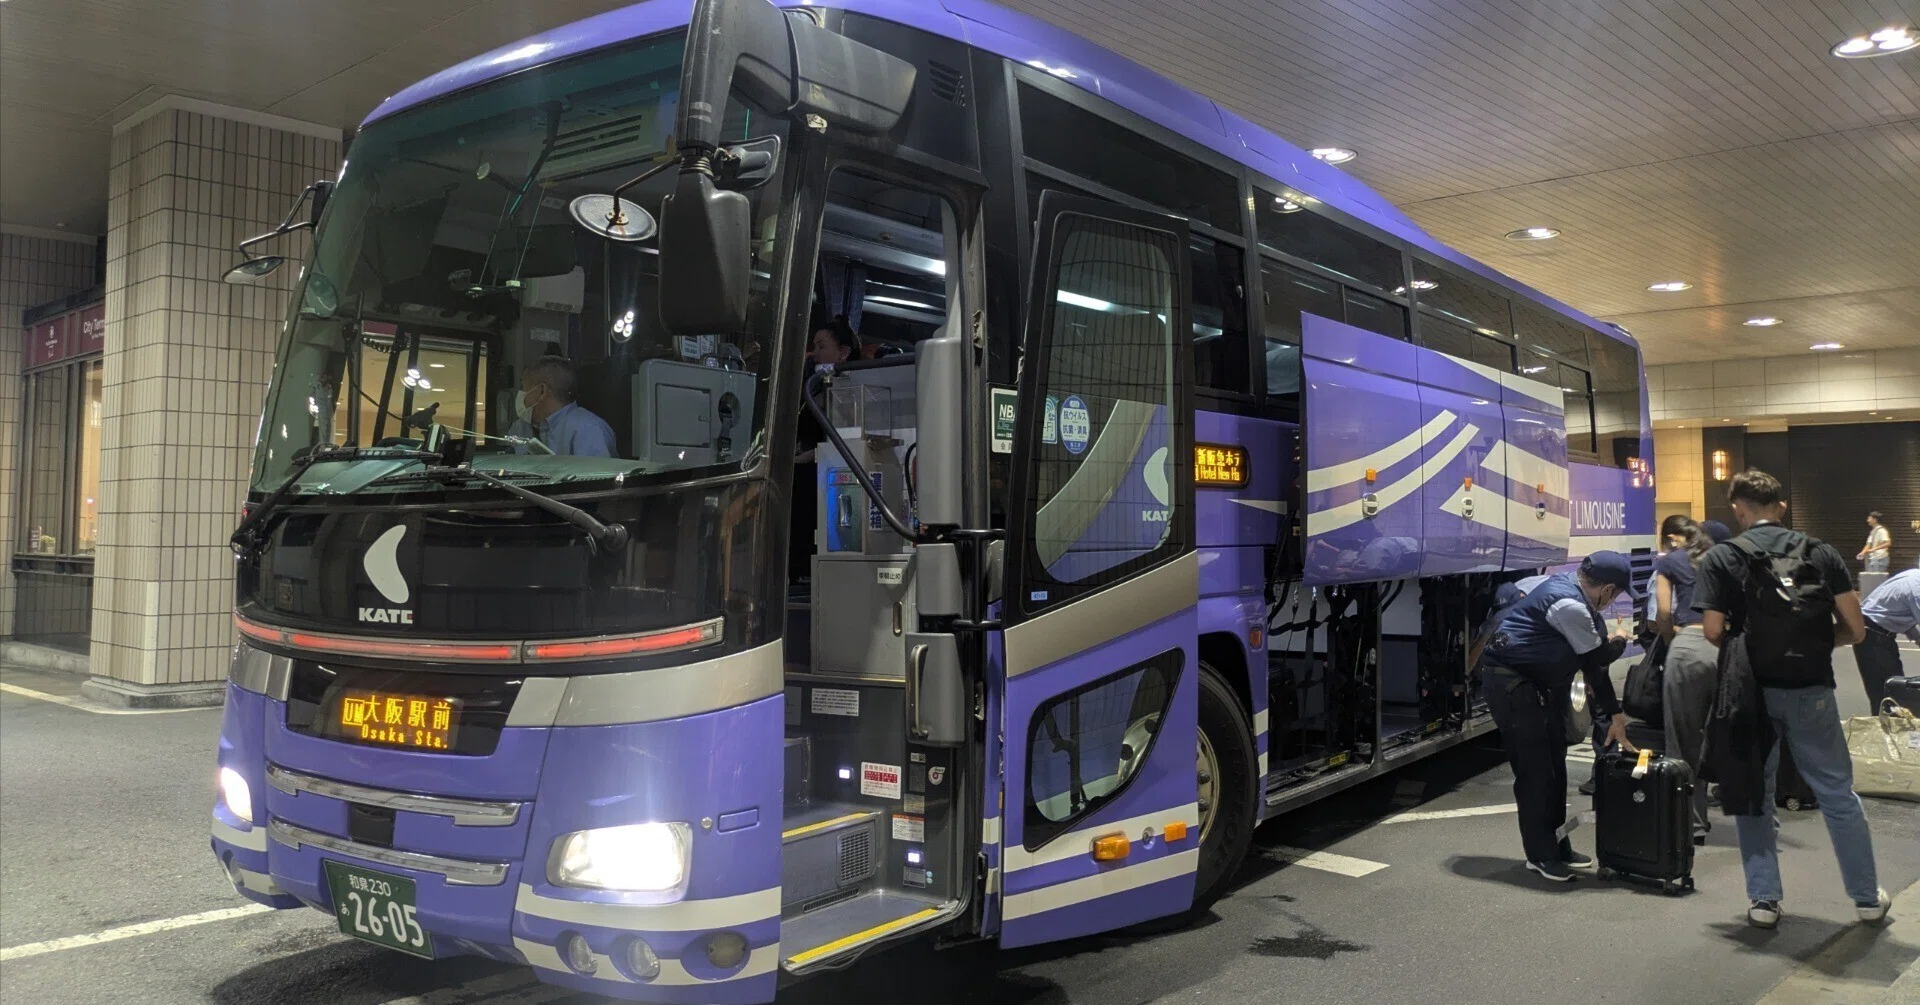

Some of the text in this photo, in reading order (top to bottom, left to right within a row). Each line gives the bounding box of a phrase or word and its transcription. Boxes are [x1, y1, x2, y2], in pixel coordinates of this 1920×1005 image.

[1000, 404, 1015, 418] NB
[1575, 501, 1626, 530] LIMOUSINE
[364, 695, 451, 731] 大阪駅前
[361, 723, 448, 749] Osaka Sta.
[348, 892, 425, 948] 26-05
